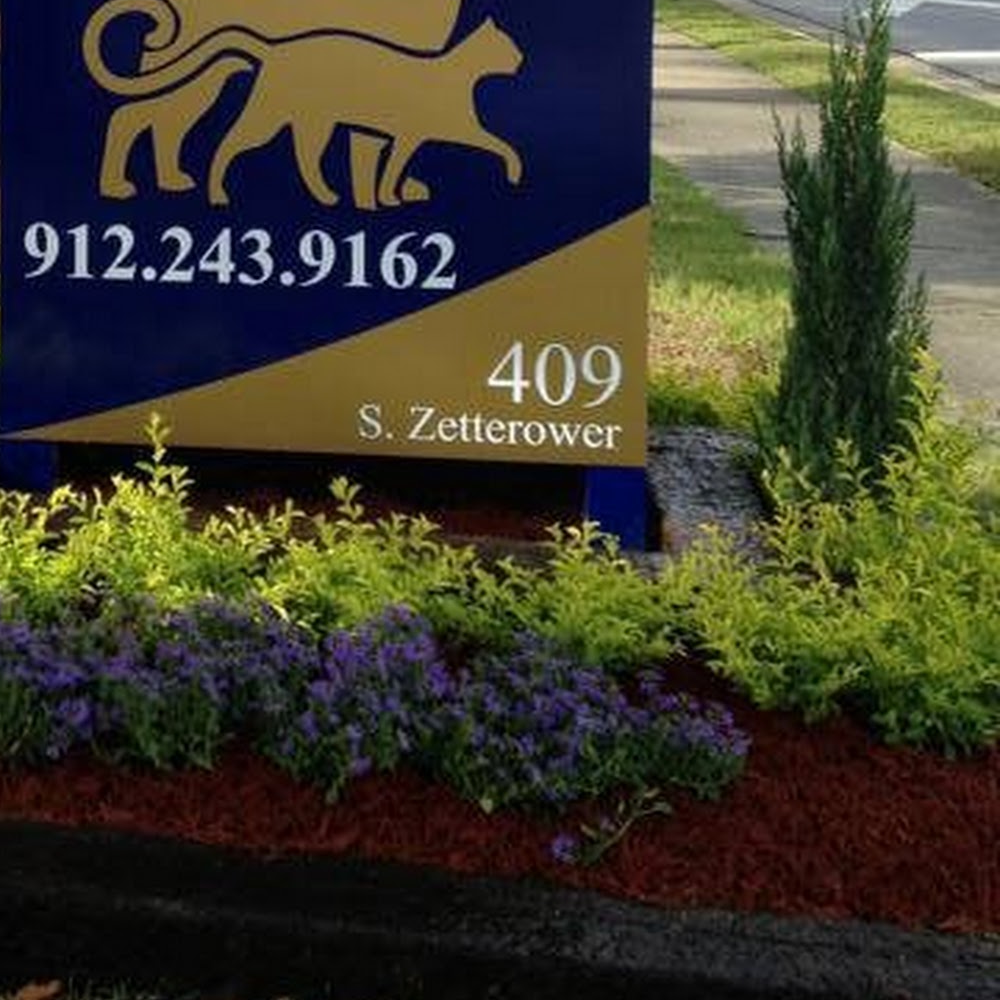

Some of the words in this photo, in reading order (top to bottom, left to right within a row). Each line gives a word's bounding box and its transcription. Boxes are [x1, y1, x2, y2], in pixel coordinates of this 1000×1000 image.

[24, 222, 458, 290] 912.243.9162
[487, 343, 622, 407] 409
[358, 405, 394, 442] S.
[409, 406, 622, 449] Zetterower
